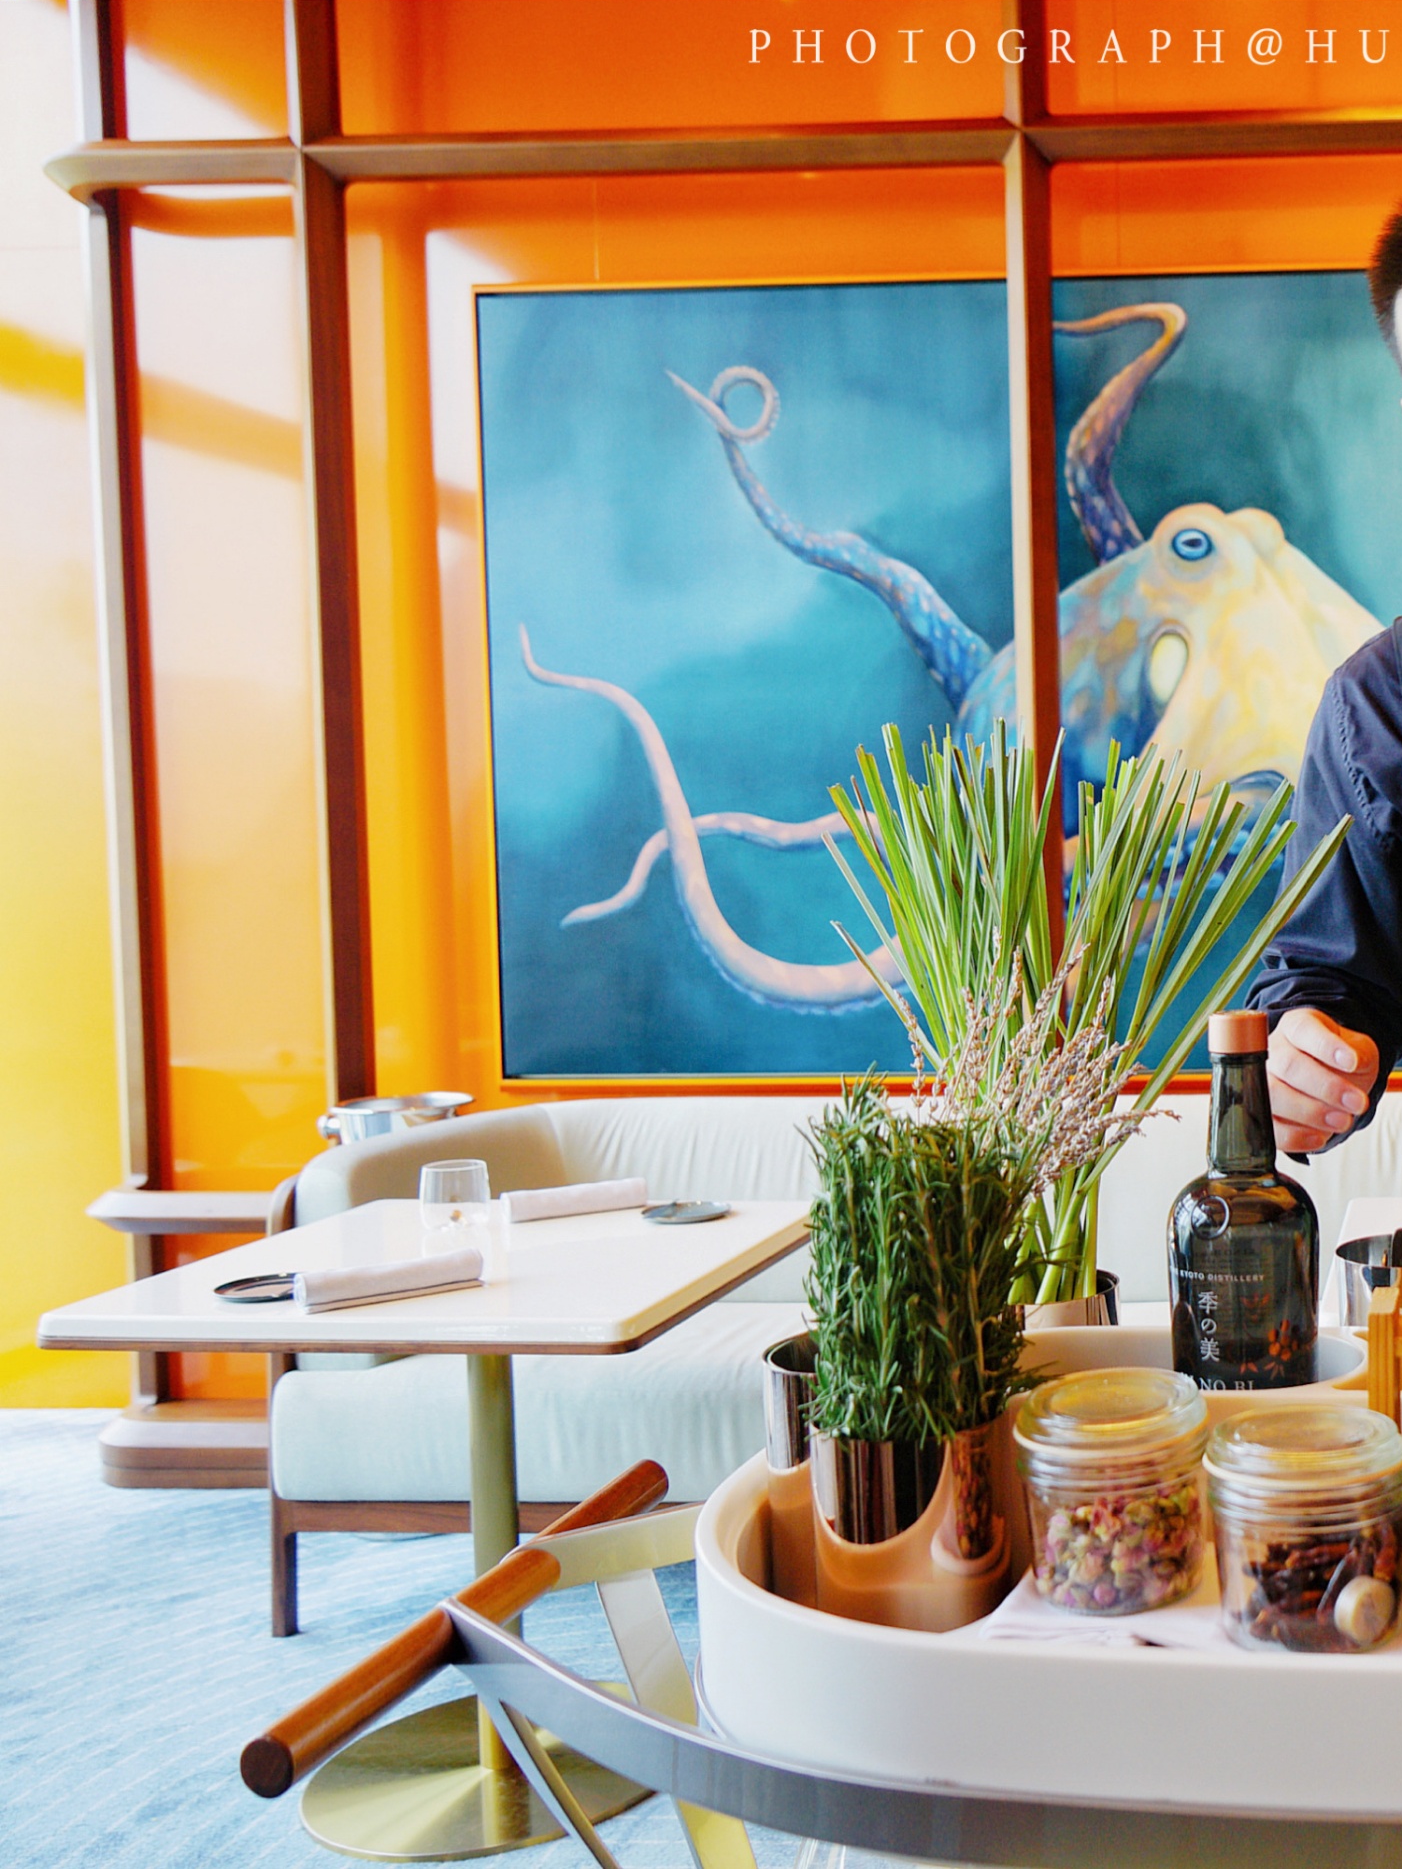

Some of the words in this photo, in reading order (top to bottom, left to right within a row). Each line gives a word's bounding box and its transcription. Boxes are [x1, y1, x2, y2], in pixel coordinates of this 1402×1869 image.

[1207, 1273, 1265, 1283] DISTILLERY
[1198, 1291, 1220, 1362] 季の美
